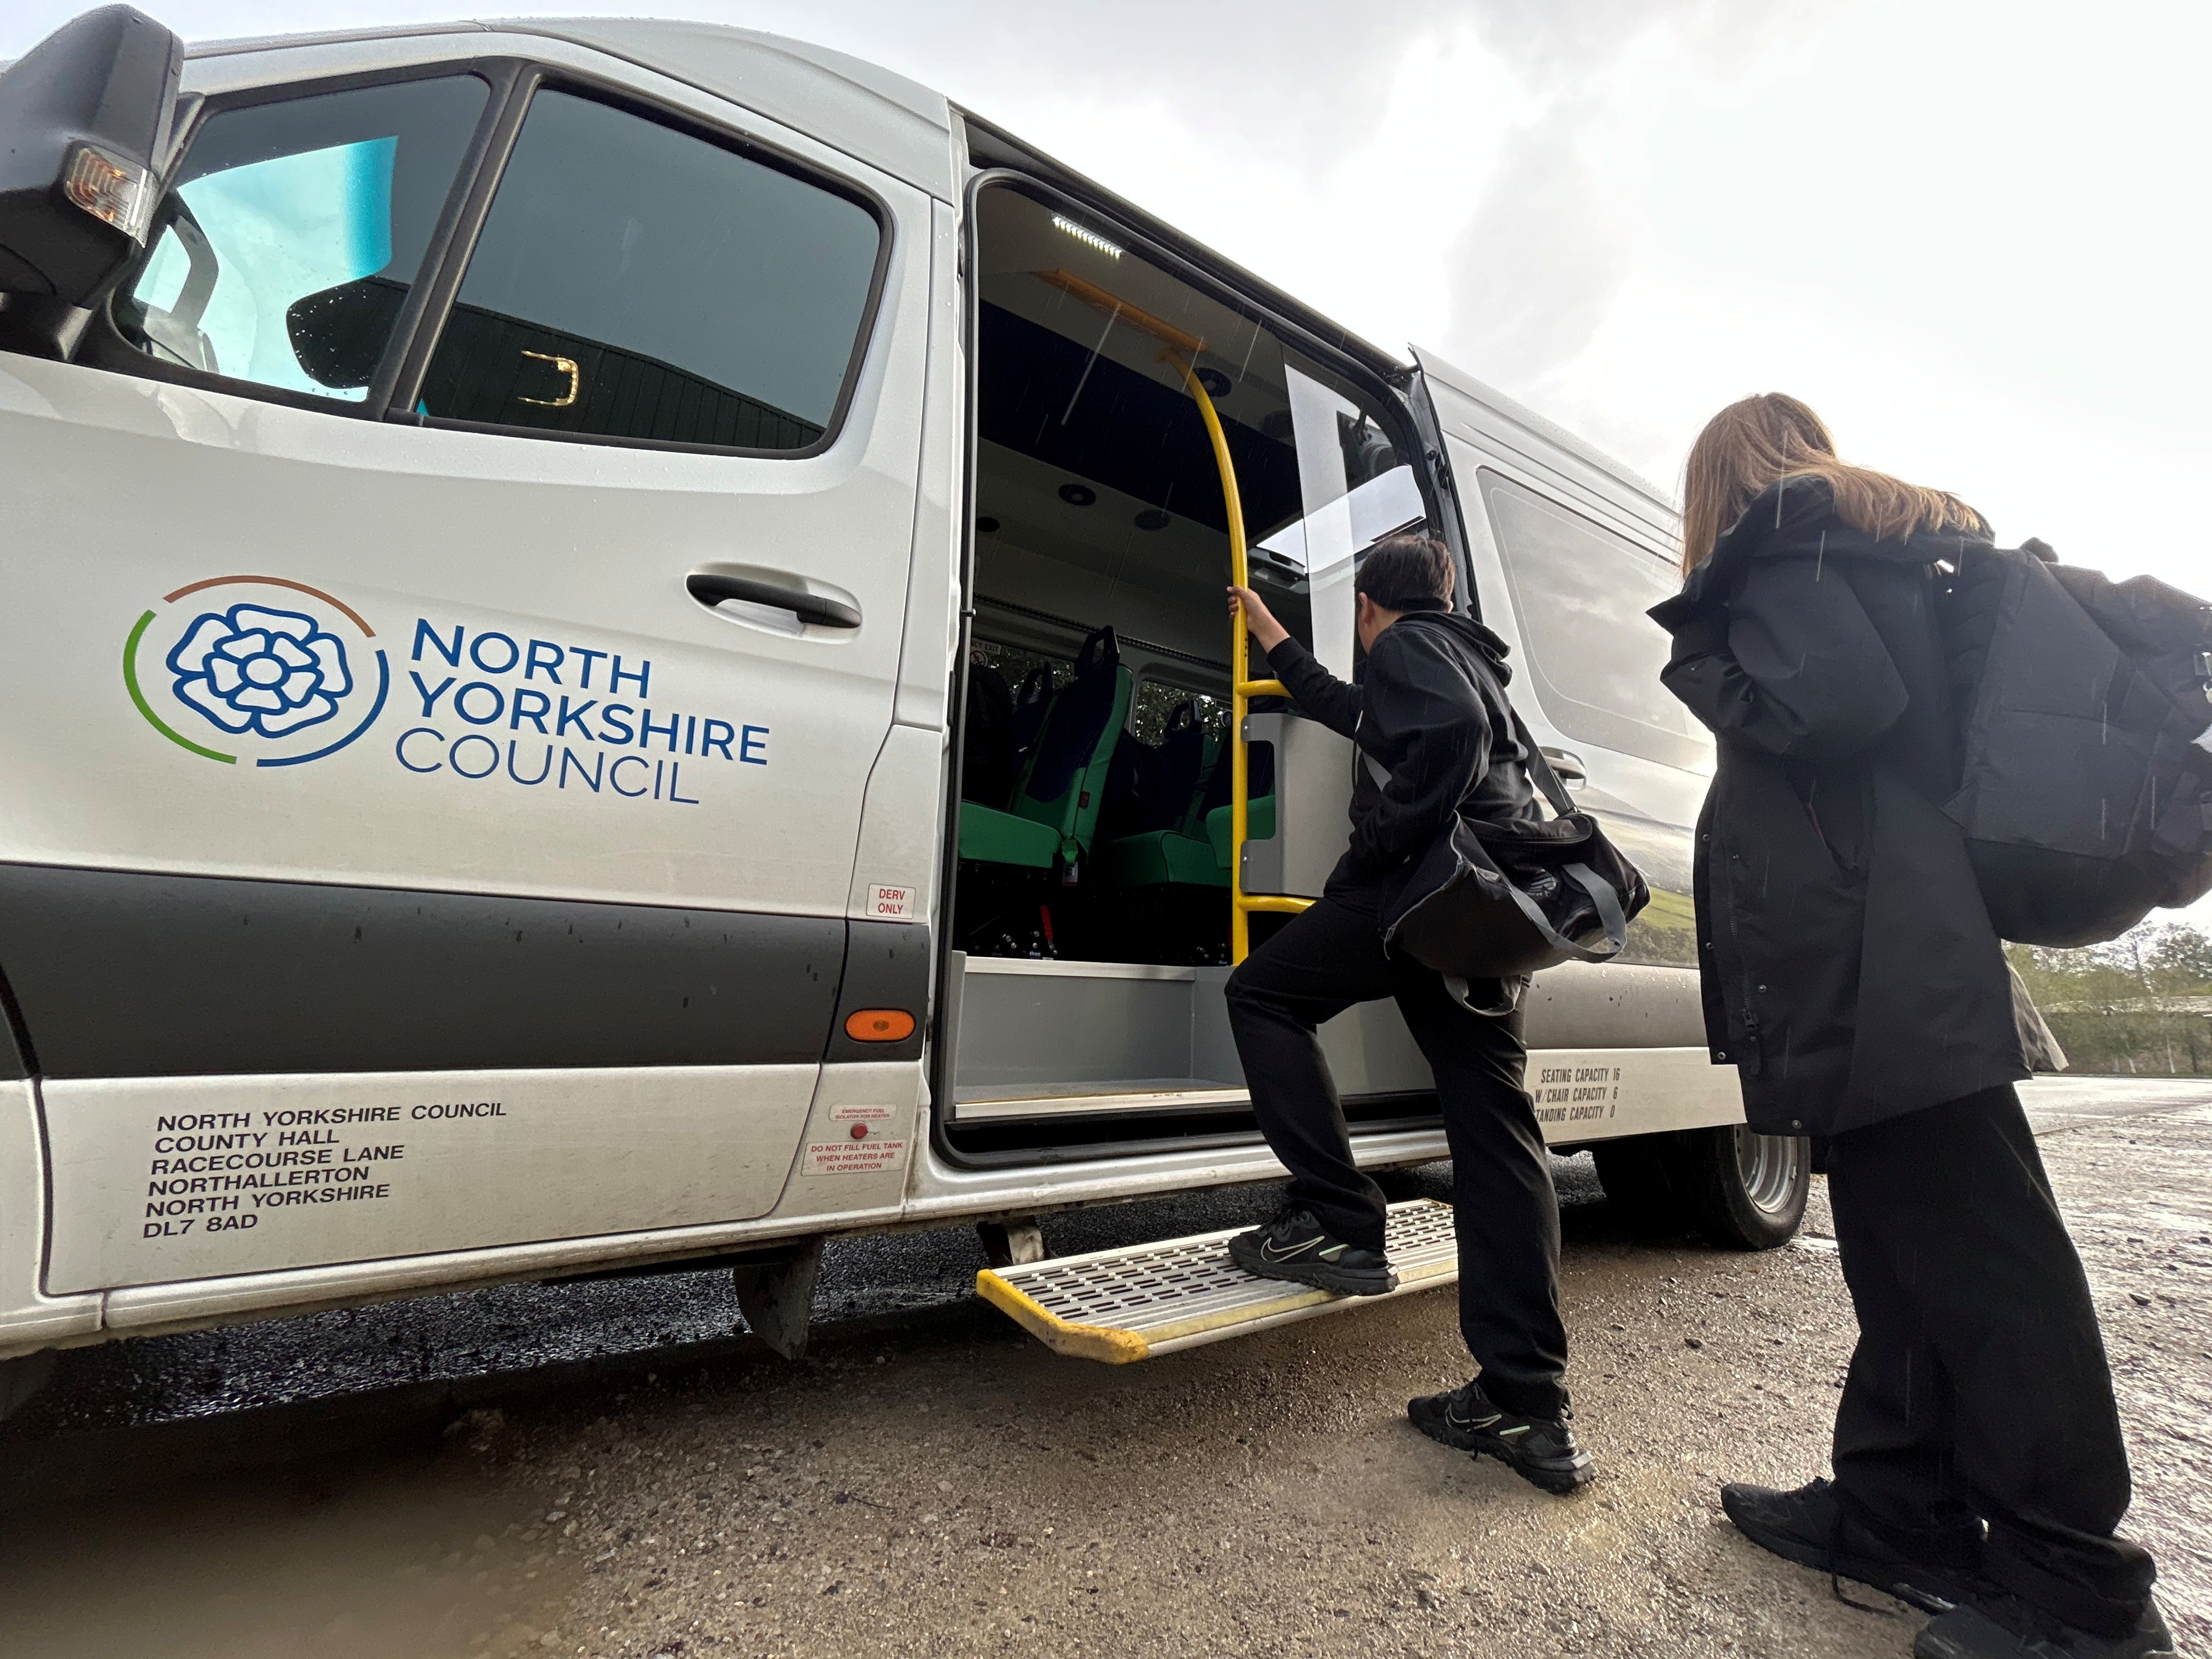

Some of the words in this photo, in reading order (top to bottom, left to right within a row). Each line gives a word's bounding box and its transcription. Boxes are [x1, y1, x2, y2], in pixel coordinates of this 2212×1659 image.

[411, 618, 652, 699] NORTH
[408, 670, 770, 765] YORKSHIRE
[395, 726, 700, 805] COUNCIL
[879, 888, 905, 900] DERV
[878, 902, 904, 914] ONLY
[1541, 1068, 1572, 1083] SEATING
[1575, 1068, 1609, 1082] CAPACITY
[1613, 1067, 1620, 1081] 16
[1536, 1088, 1569, 1103] W/CHAIR
[1573, 1086, 1607, 1102] CAPACITY
[1613, 1086, 1618, 1099] 6
[157, 1112, 251, 1132] NORTH
[263, 1106, 402, 1127] YORKSHIRE
[411, 1102, 507, 1121] COUNCIL
[1536, 1108, 1566, 1122] TANDING
[1570, 1105, 1604, 1120] CAPACITY
[155, 1132, 268, 1154] COUNTY
[278, 1129, 340, 1147] HALL
[150, 1149, 332, 1176] RACECOURSE
[343, 1144, 405, 1163] LANE
[837, 1163, 882, 1171] OPERATION
[148, 1166, 370, 1197] NORTHALLERTON
[145, 1195, 240, 1218] NORTH
[252, 1184, 390, 1208] YORKSHIRE
[143, 1218, 195, 1239] DL7
[206, 1214, 258, 1233] 8AD
